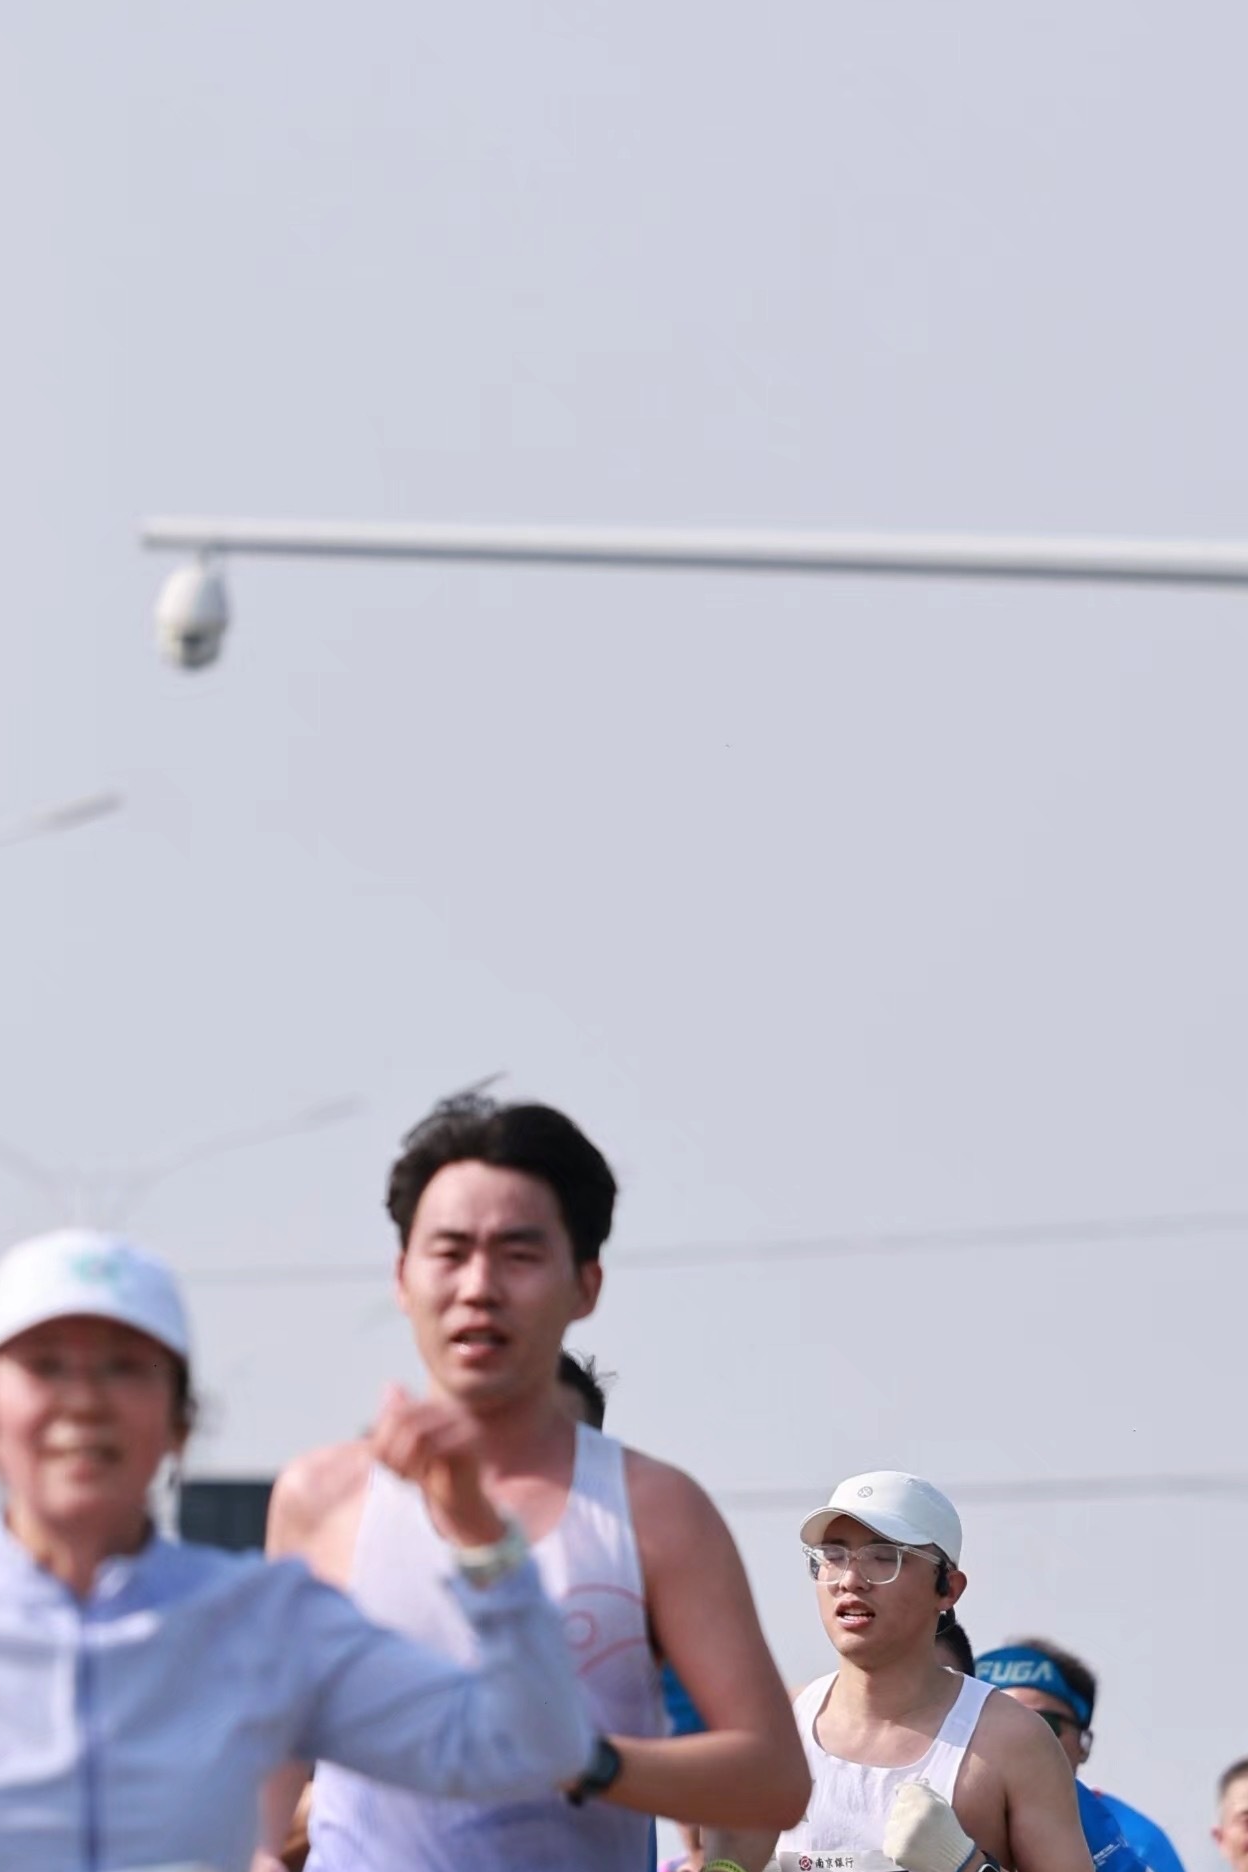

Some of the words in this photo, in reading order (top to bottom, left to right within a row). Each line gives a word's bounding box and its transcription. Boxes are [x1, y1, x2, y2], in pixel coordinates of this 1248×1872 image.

[975, 1660, 1053, 1682] FUGA
[815, 1857, 854, 1868] 南京银行
